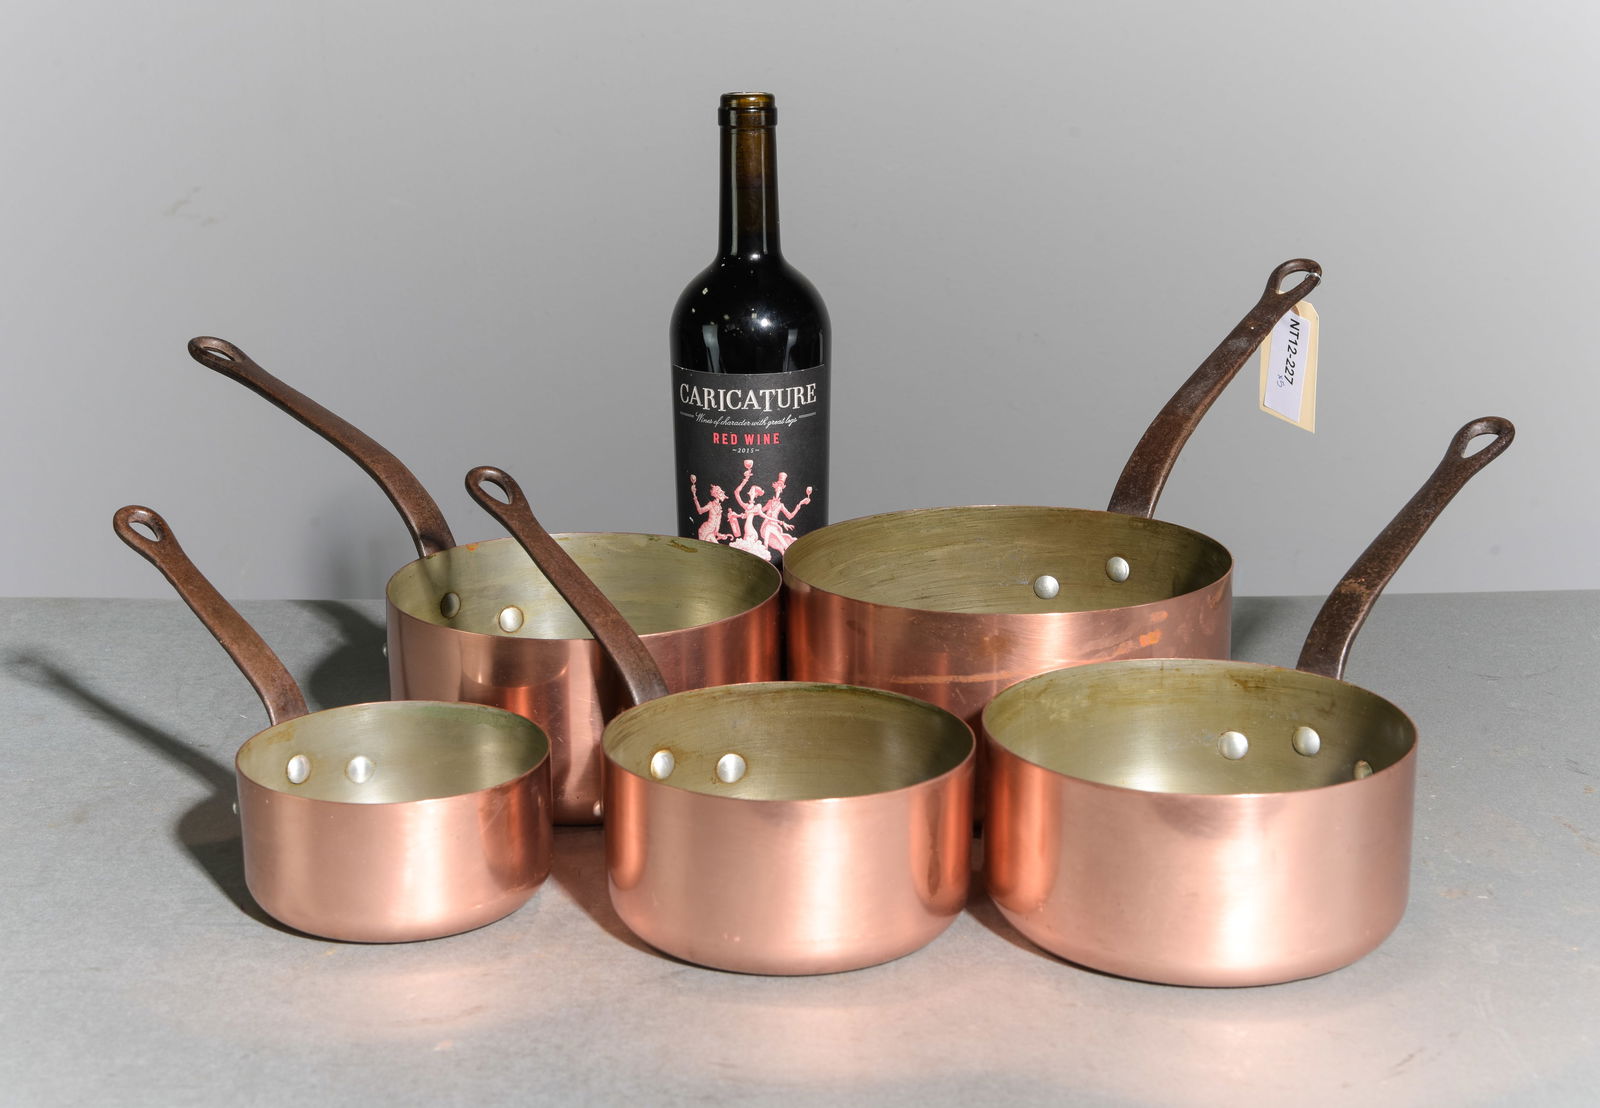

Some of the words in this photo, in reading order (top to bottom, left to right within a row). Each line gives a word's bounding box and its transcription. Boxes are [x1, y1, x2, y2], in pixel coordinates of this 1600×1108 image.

[1284, 318, 1300, 385] NT12-227
[680, 383, 816, 411] CARICATURE
[695, 412, 713, 424] Wines
[712, 416, 724, 427] of
[720, 416, 750, 426] character
[751, 416, 769, 426] with
[765, 417, 786, 429] great
[713, 432, 738, 445] RED
[744, 432, 780, 445] WINE
